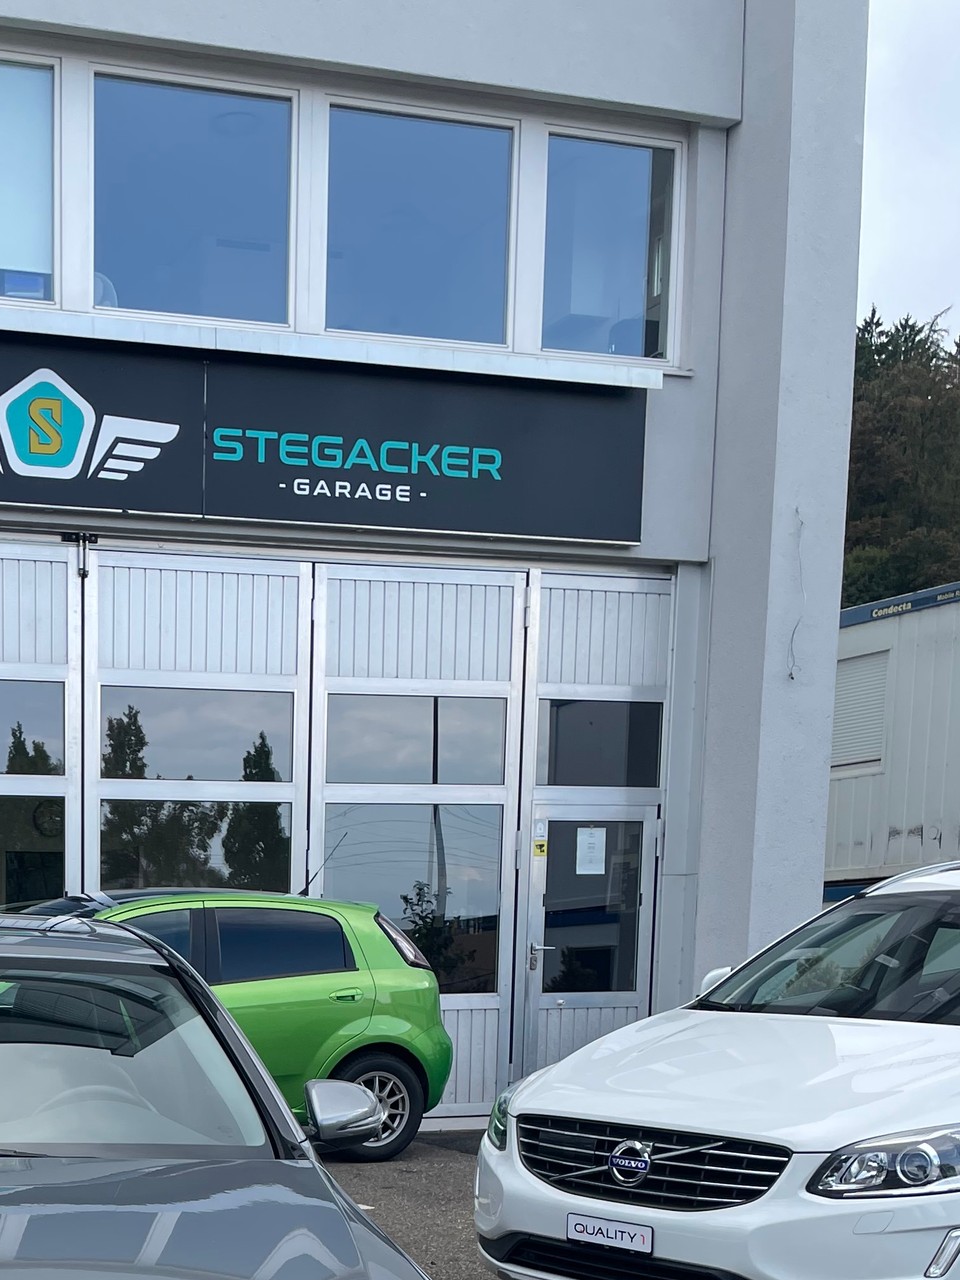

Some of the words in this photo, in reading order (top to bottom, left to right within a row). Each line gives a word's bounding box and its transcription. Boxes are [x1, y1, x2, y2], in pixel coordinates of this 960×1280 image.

[28, 397, 63, 455] S
[212, 427, 502, 481] STEGACKER
[872, 602, 912, 617] Condecta
[937, 592, 954, 601] Mobile
[611, 1157, 646, 1169] VOLVO
[574, 1223, 637, 1243] QUALITY
[641, 1234, 645, 1245] 1
